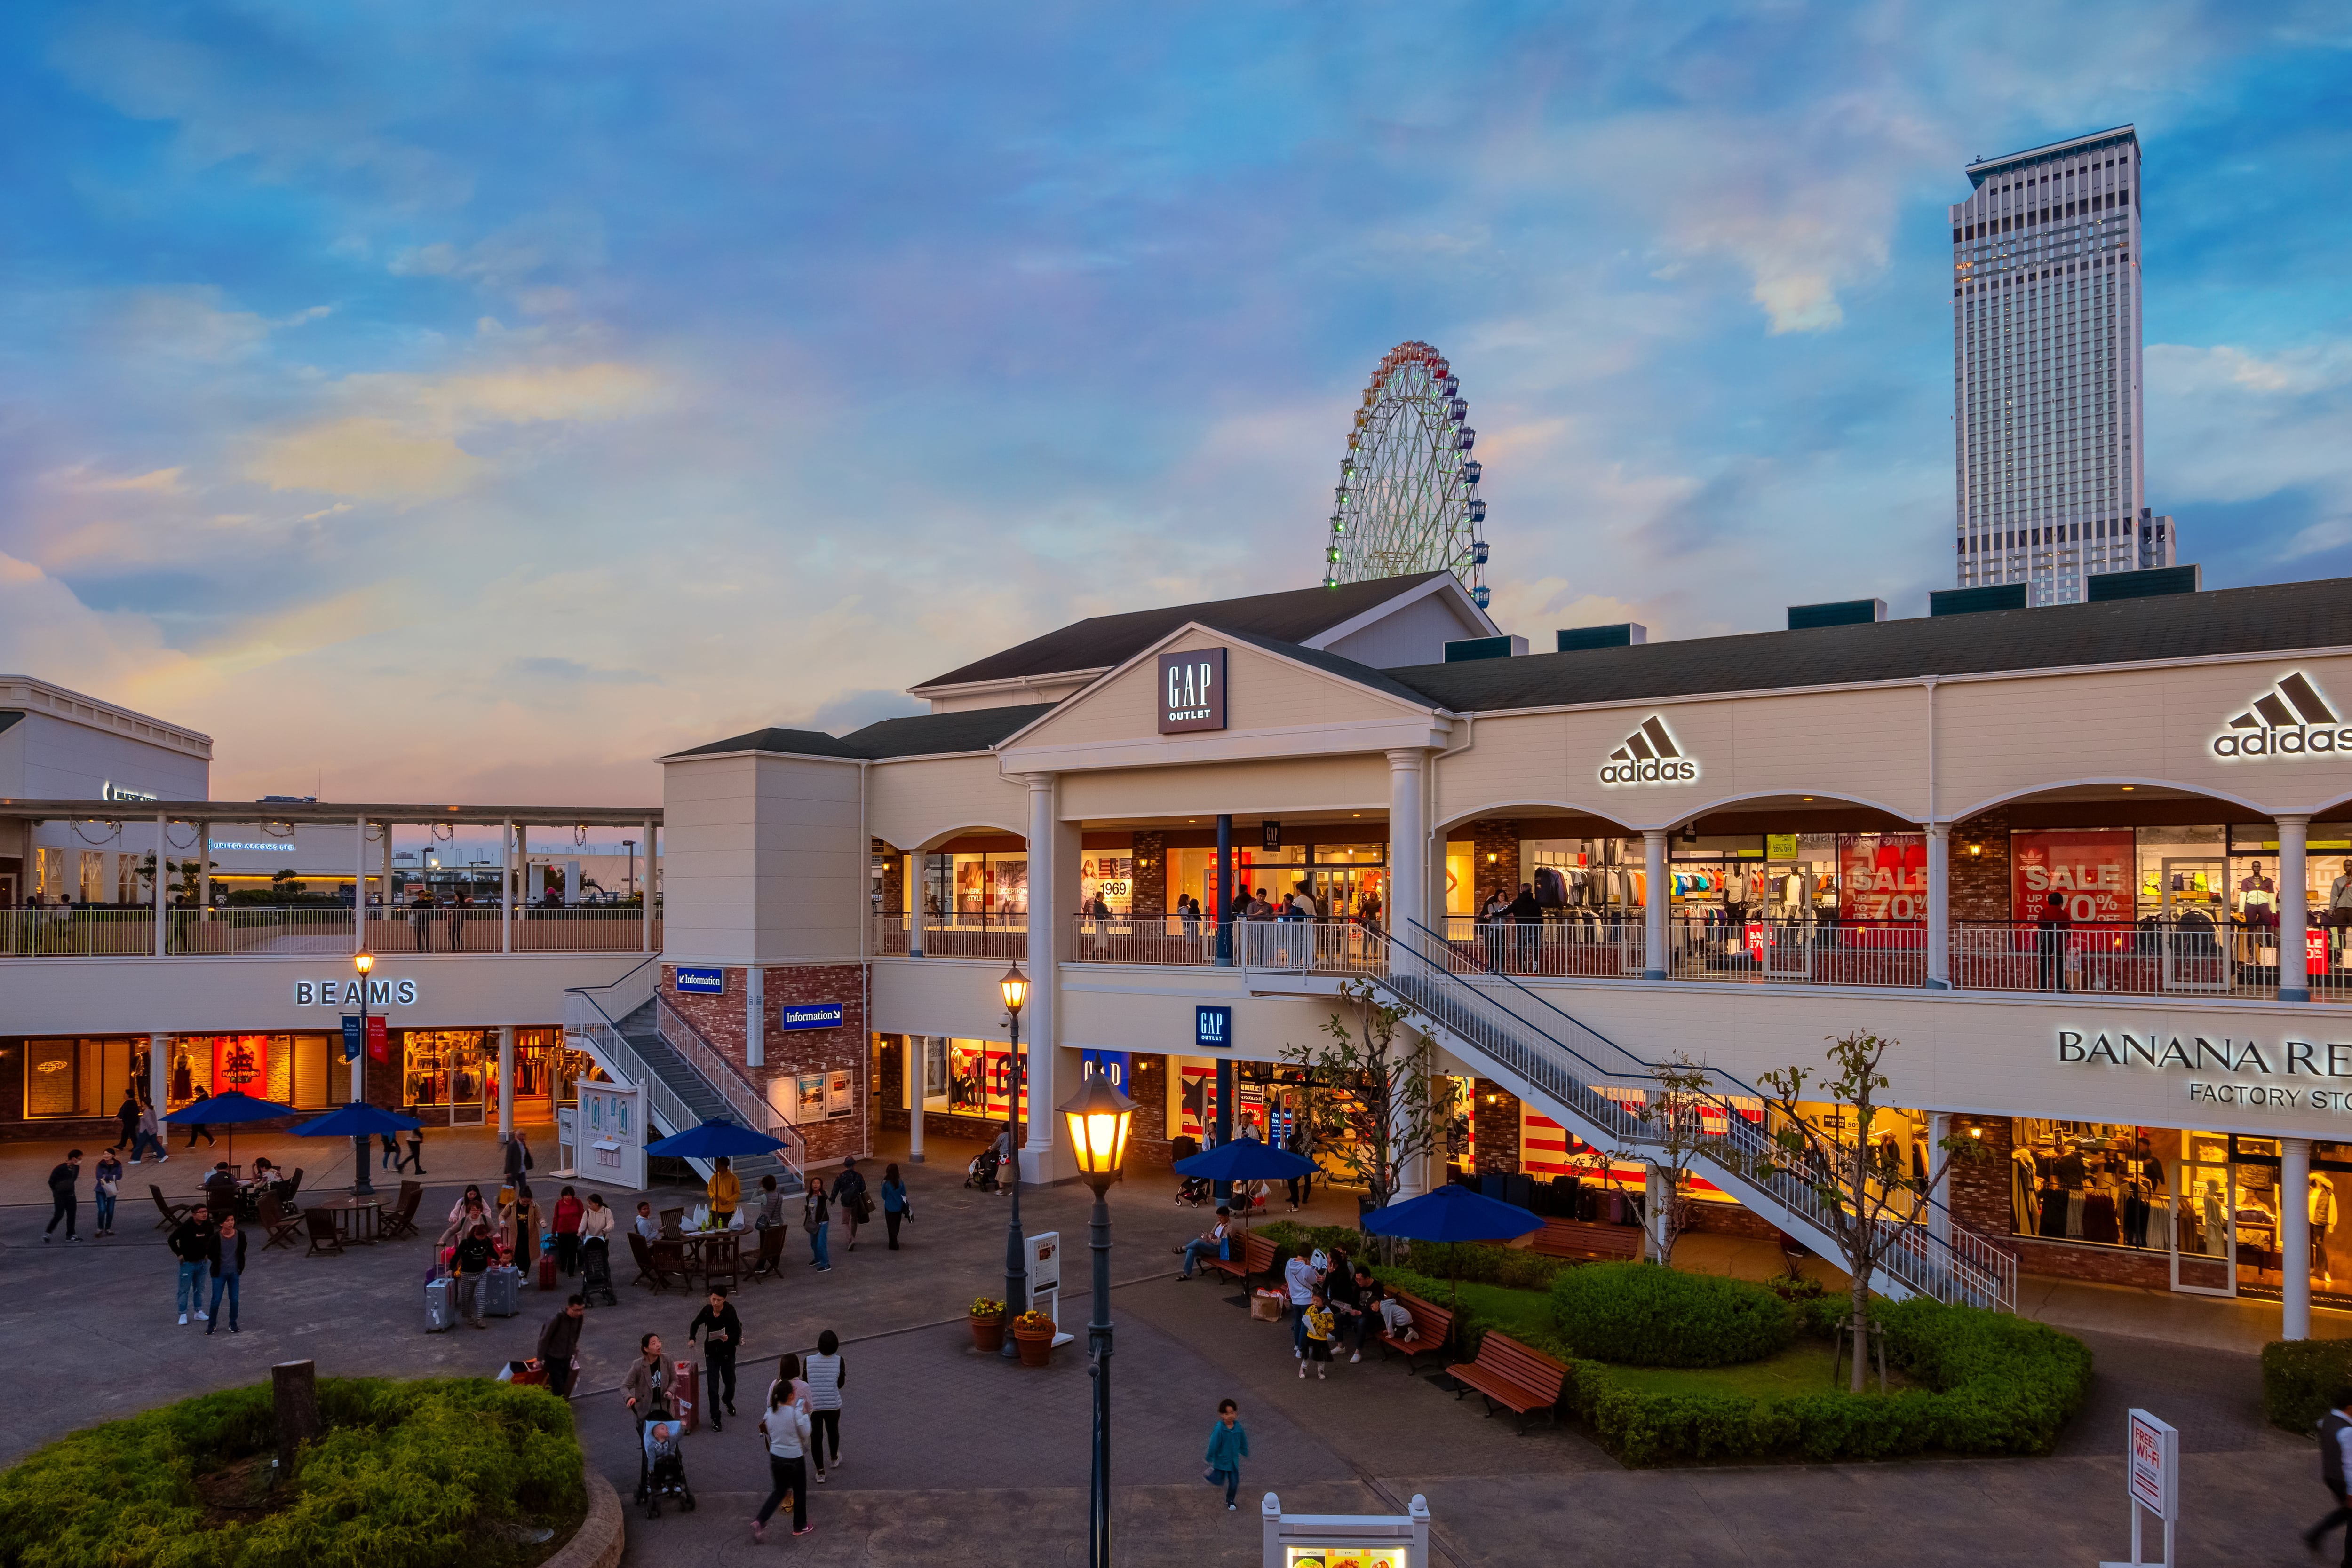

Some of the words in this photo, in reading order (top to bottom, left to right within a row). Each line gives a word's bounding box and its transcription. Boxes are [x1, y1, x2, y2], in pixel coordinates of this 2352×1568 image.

[1169, 664, 1211, 708] GAP
[1169, 709, 1211, 721] OUTLET
[2214, 725, 2352, 756] adidas
[1600, 758, 1695, 783] adidas
[1267, 827, 1278, 841] GAP
[1100, 882, 1126, 895] 1969
[2026, 865, 2120, 891] SALE
[685, 974, 720, 985] Information
[297, 982, 414, 1005] BEAMS
[786, 1010, 833, 1022] Information
[1201, 1013, 1222, 1034] GAP
[2058, 1031, 2272, 1073] BANANA
[2287, 1042, 2352, 1077] RE
[2190, 1083, 2301, 1107] FACTORY
[2136, 1427, 2153, 1449] FREE
[2136, 1440, 2159, 1469] Wi-Fi
